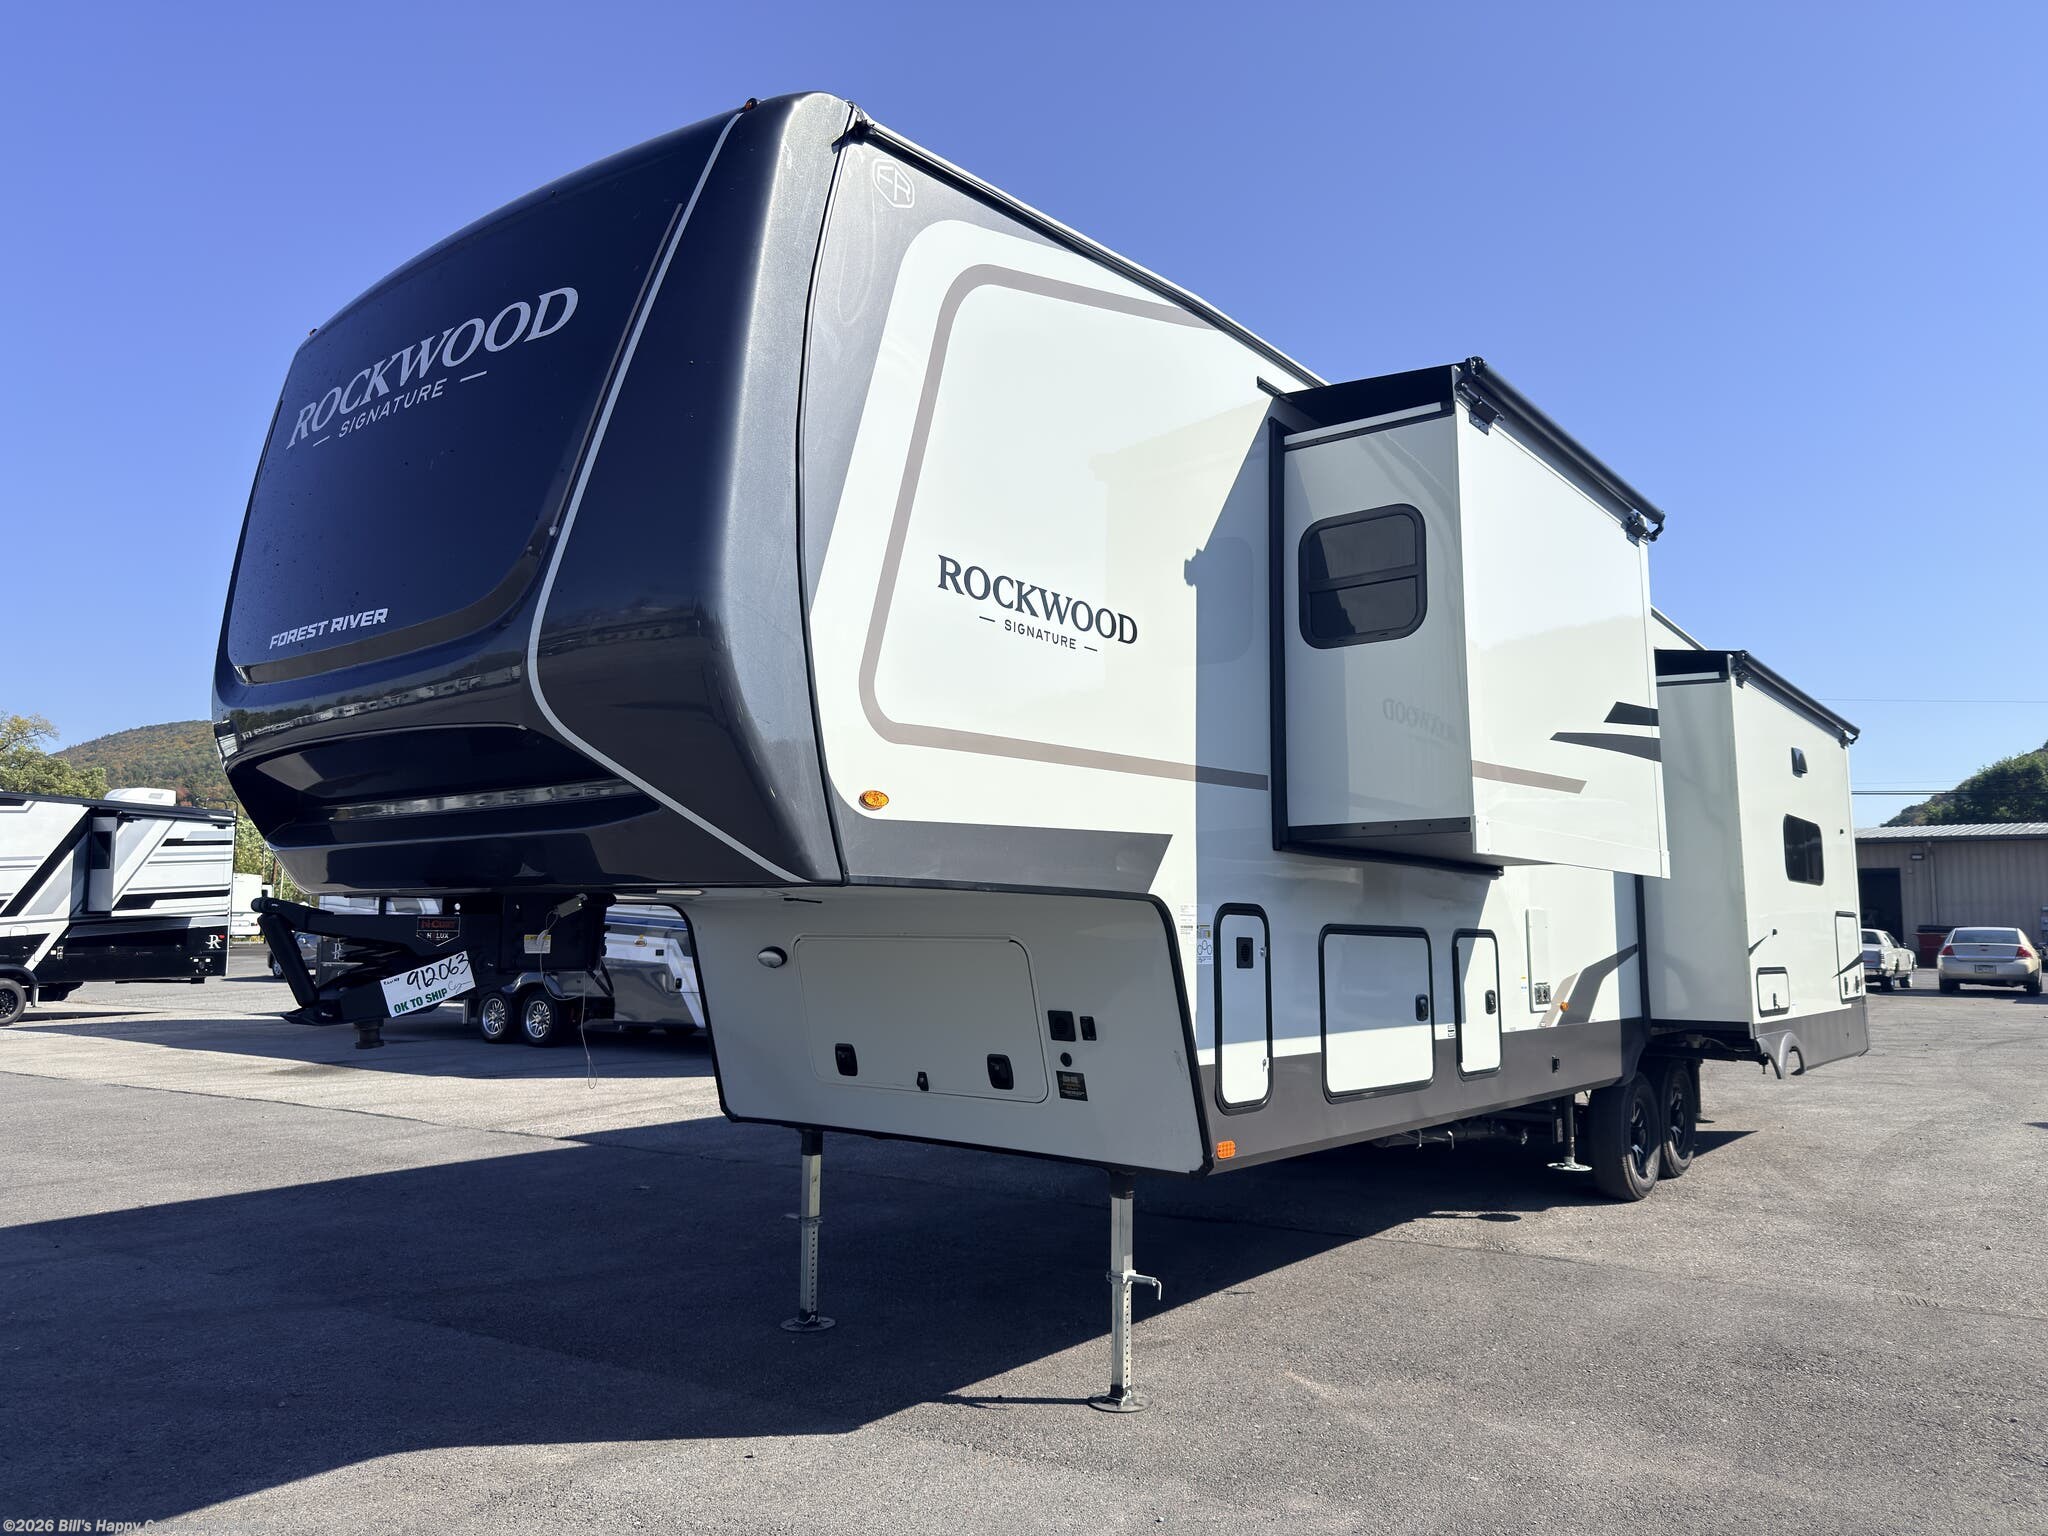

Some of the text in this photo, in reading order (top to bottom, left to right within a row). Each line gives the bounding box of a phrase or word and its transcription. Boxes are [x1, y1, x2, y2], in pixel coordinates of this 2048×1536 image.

[286, 286, 580, 450] ROCKWOOD
[338, 377, 449, 438] SIGNATURE
[937, 554, 1138, 645] ROCKWOOD
[269, 607, 389, 650] FOREST RIVER
[1004, 619, 1077, 650] SIGNATURE
[406, 952, 469, 990] 912063
[393, 1000, 410, 1014] OK
[410, 996, 424, 1008] TO
[425, 987, 448, 1003] SHIP
